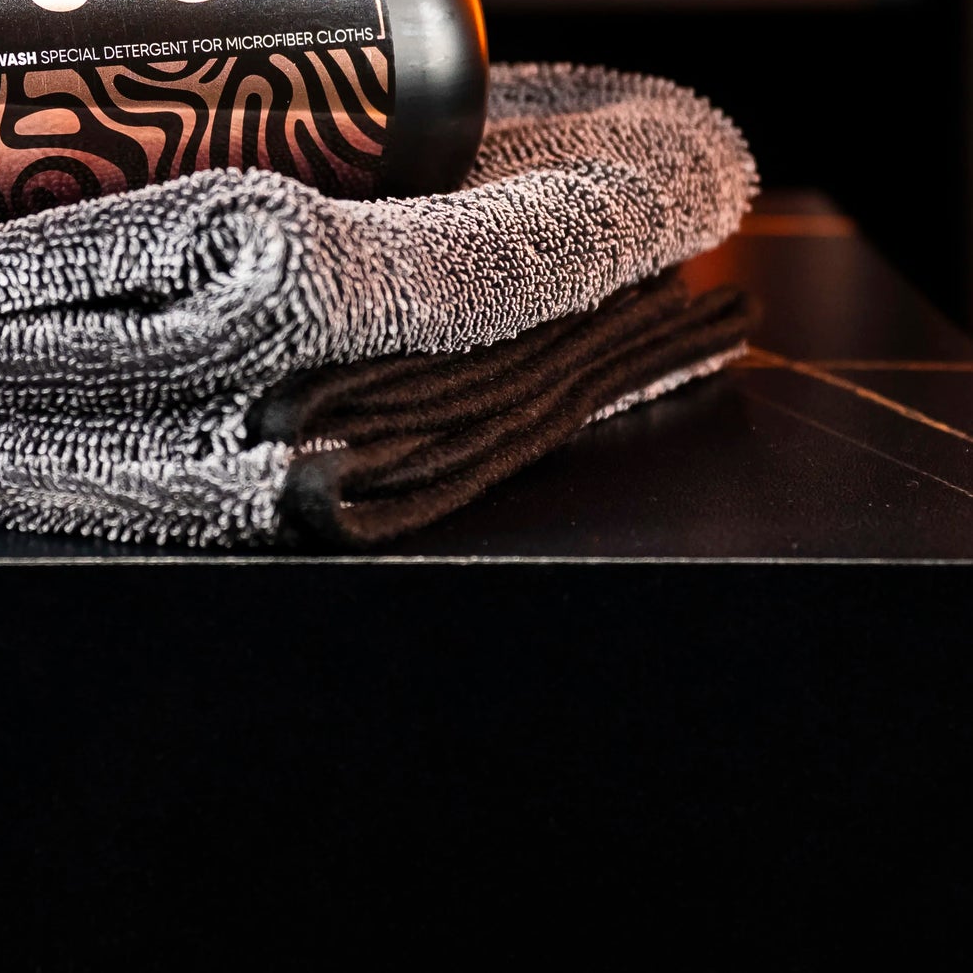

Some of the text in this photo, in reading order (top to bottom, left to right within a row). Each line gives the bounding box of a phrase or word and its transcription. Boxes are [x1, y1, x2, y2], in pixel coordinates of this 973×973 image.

[40, 47, 101, 64] SPECIAL
[103, 40, 188, 61] DETERGENT
[192, 38, 223, 53] FOR
[226, 32, 314, 51] MICROFIBER
[316, 27, 374, 44] CLOTHS
